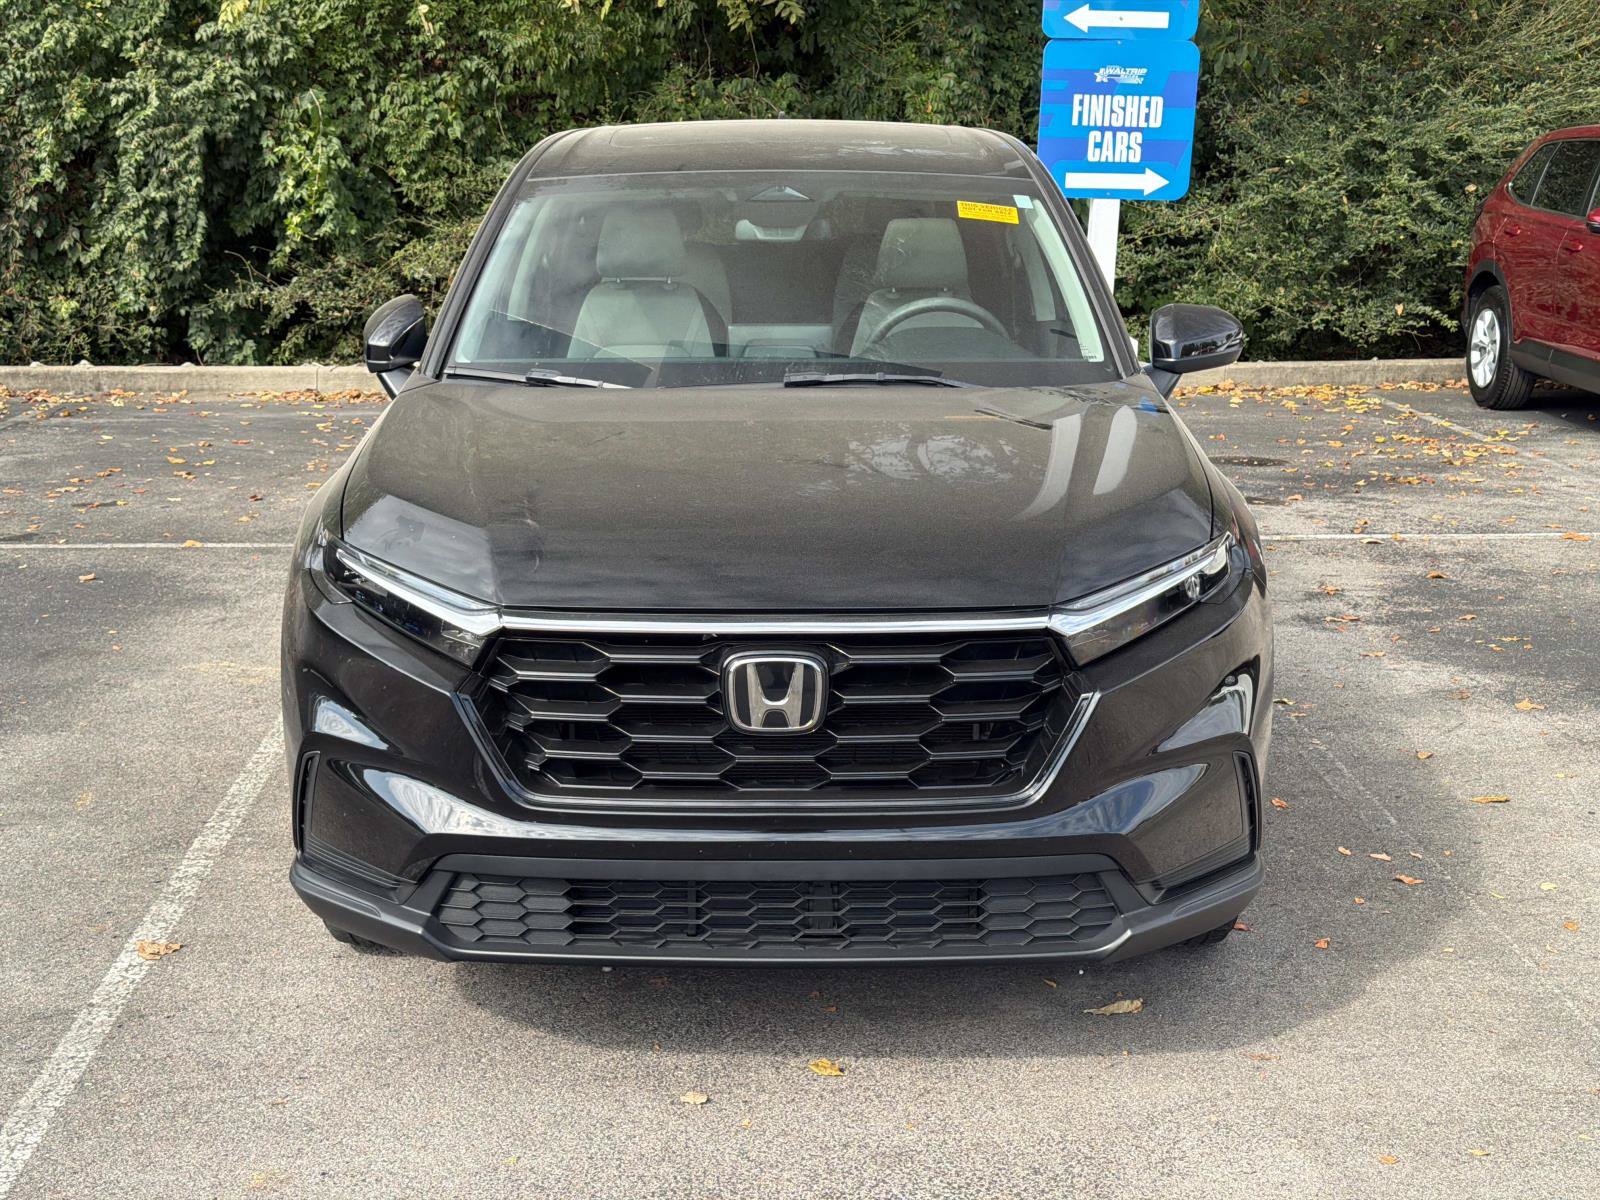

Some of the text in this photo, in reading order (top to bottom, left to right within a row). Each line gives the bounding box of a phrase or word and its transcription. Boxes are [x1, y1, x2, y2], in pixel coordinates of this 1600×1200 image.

[1105, 67, 1148, 75] WALTRIP
[1071, 93, 1164, 128] FINISHED
[1087, 130, 1143, 163] CARS
